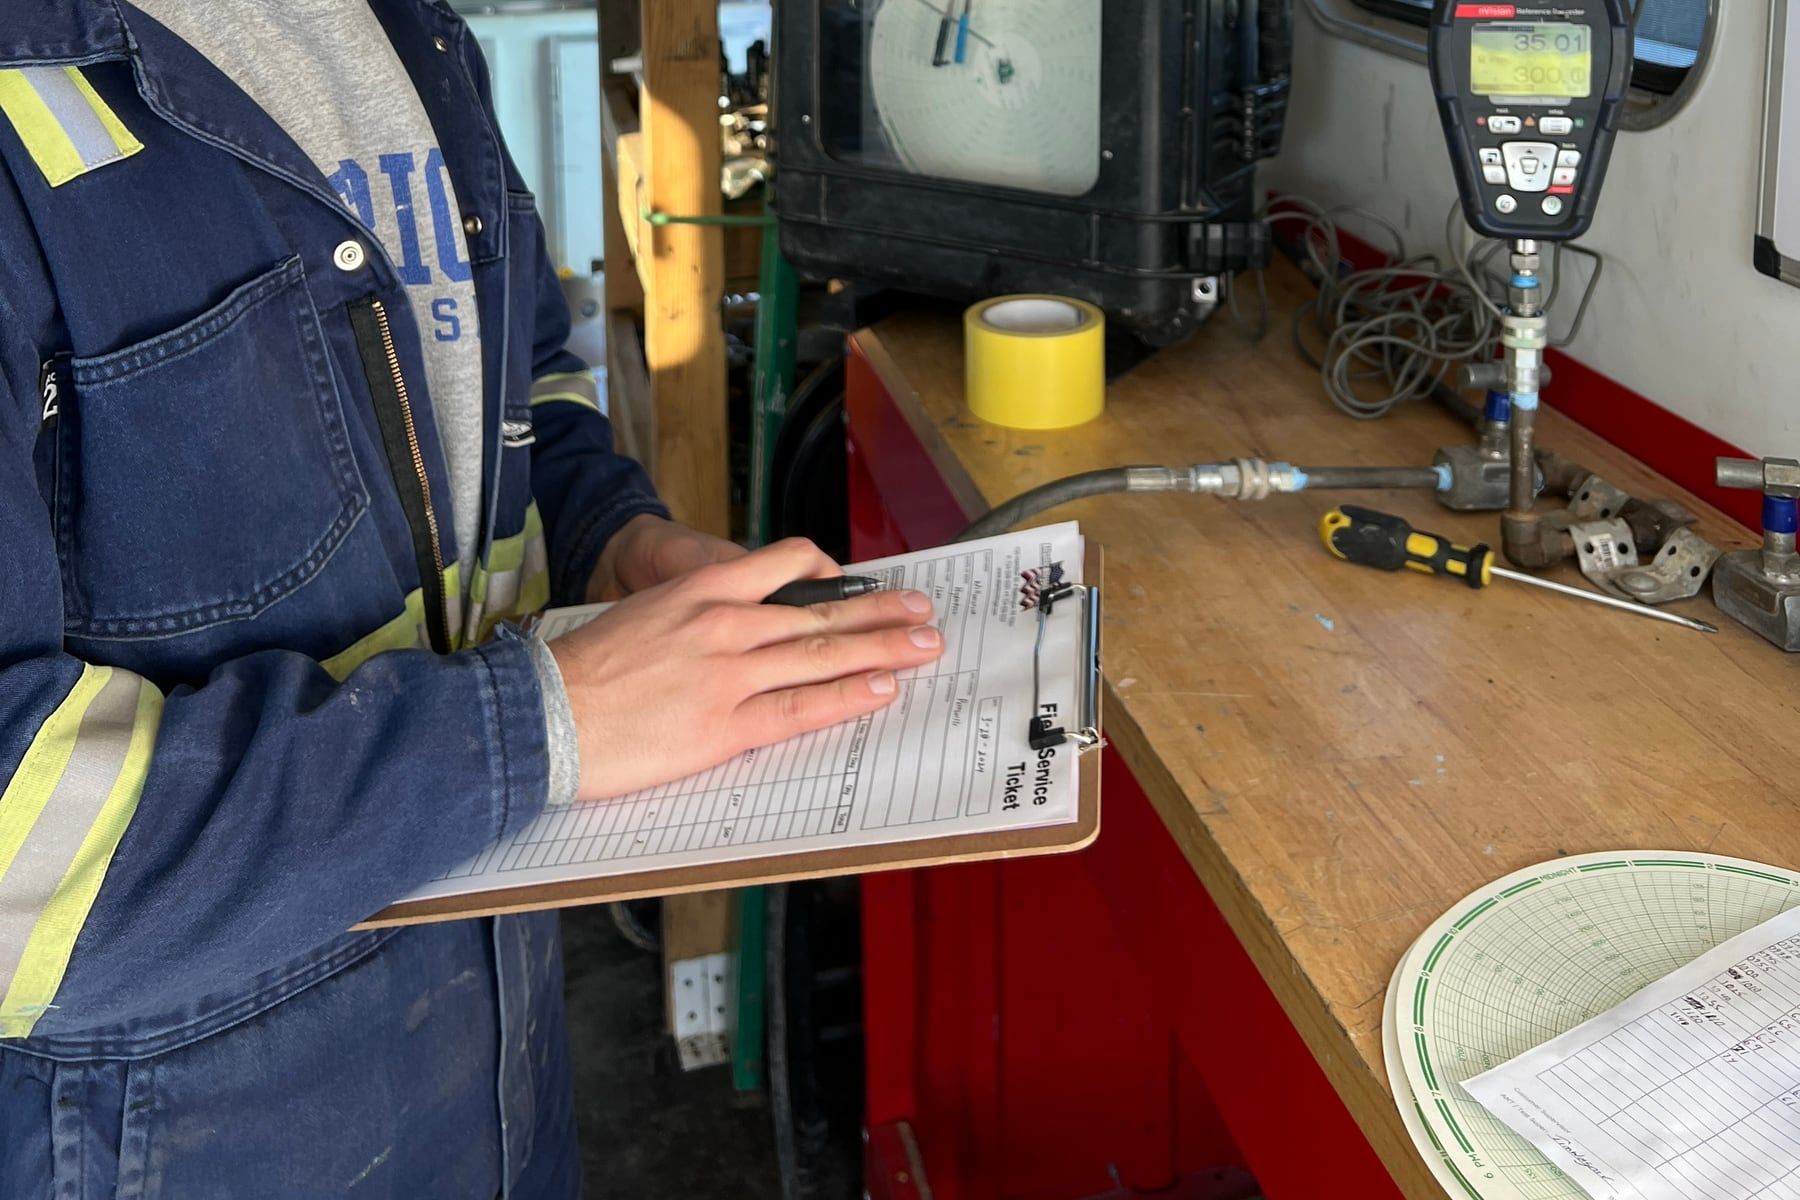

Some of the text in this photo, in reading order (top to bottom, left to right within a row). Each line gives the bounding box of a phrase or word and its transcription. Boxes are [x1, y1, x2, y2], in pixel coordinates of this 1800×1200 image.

[1516, 7, 1551, 16] Reference
[1033, 748, 1056, 806] Service
[1002, 761, 1027, 811] Ticket
[1540, 866, 1577, 882] MIDNIGHT
[1468, 1153, 1485, 1169] PM
